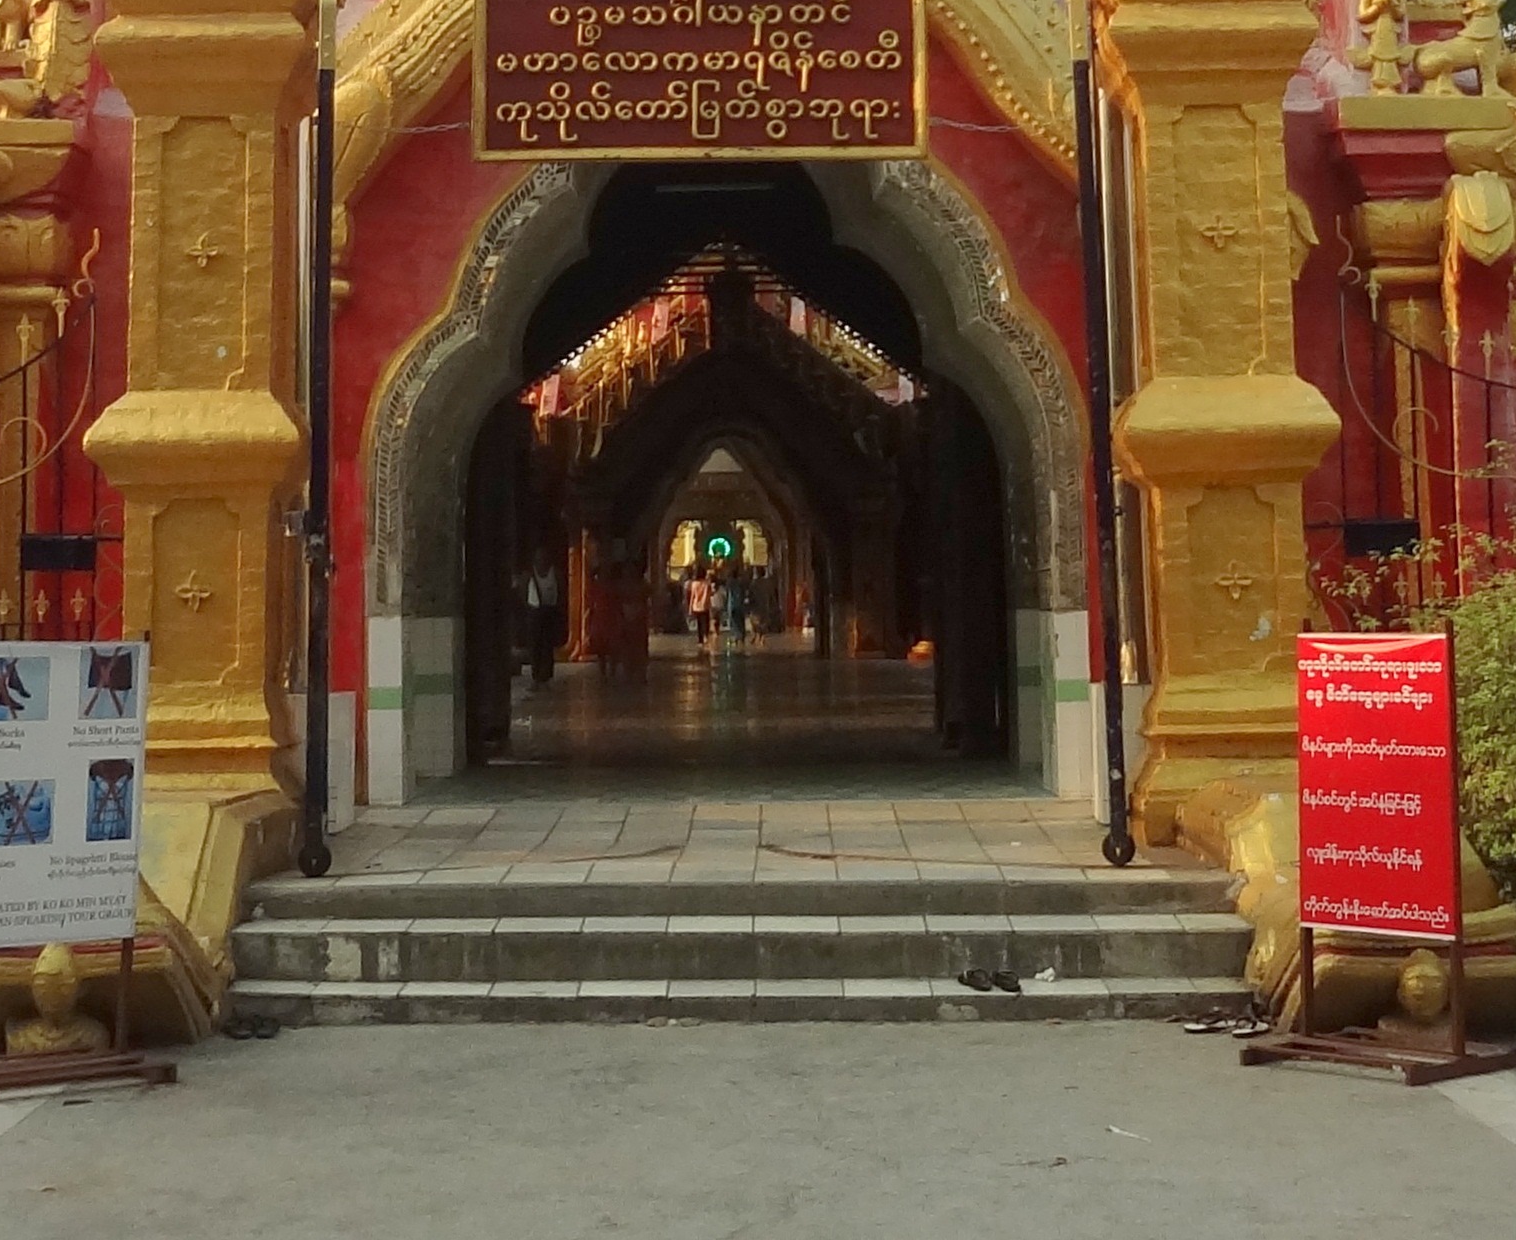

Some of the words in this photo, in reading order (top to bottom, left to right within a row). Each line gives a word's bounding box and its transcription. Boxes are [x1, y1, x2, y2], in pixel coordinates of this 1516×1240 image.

[72, 726, 86, 736] No
[49, 856, 63, 865] No
[27, 900, 39, 912] BY
